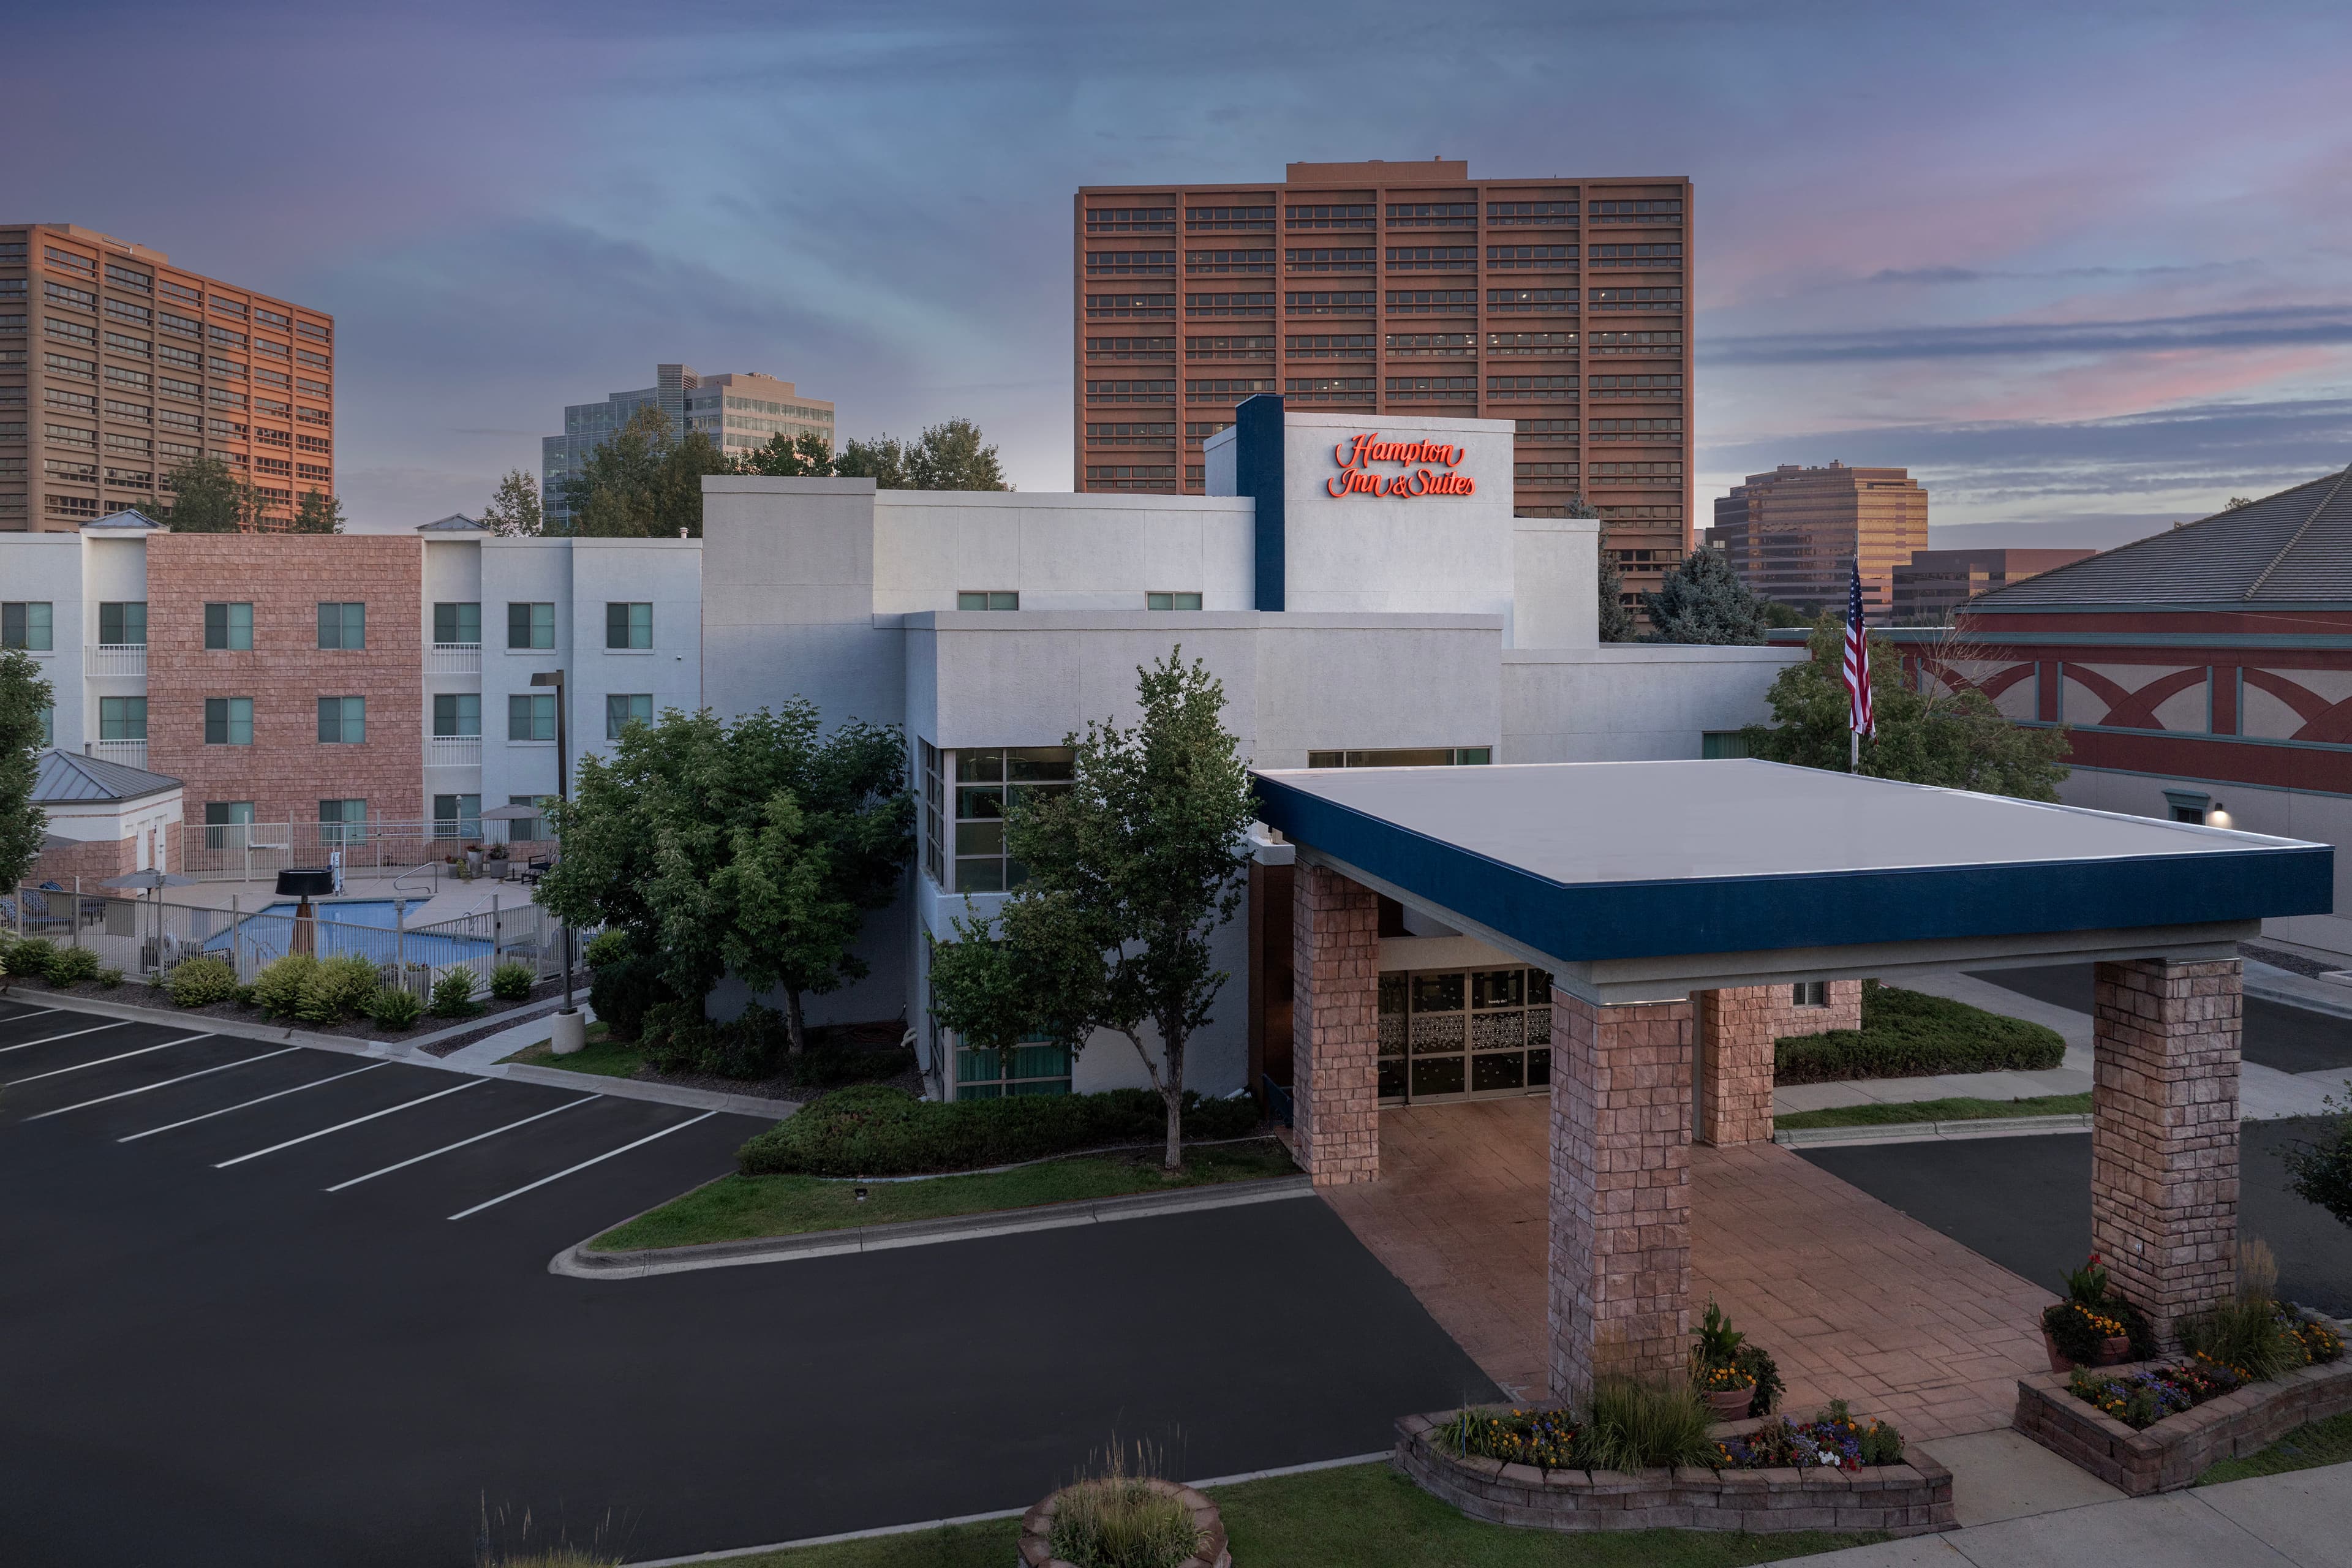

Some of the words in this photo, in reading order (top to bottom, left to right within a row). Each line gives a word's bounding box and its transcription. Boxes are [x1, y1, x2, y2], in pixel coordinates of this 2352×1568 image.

[1335, 432, 1465, 468] Hampton
[1327, 467, 1393, 497] Inn
[1393, 475, 1411, 498] &
[1408, 469, 1476, 496] Suites
